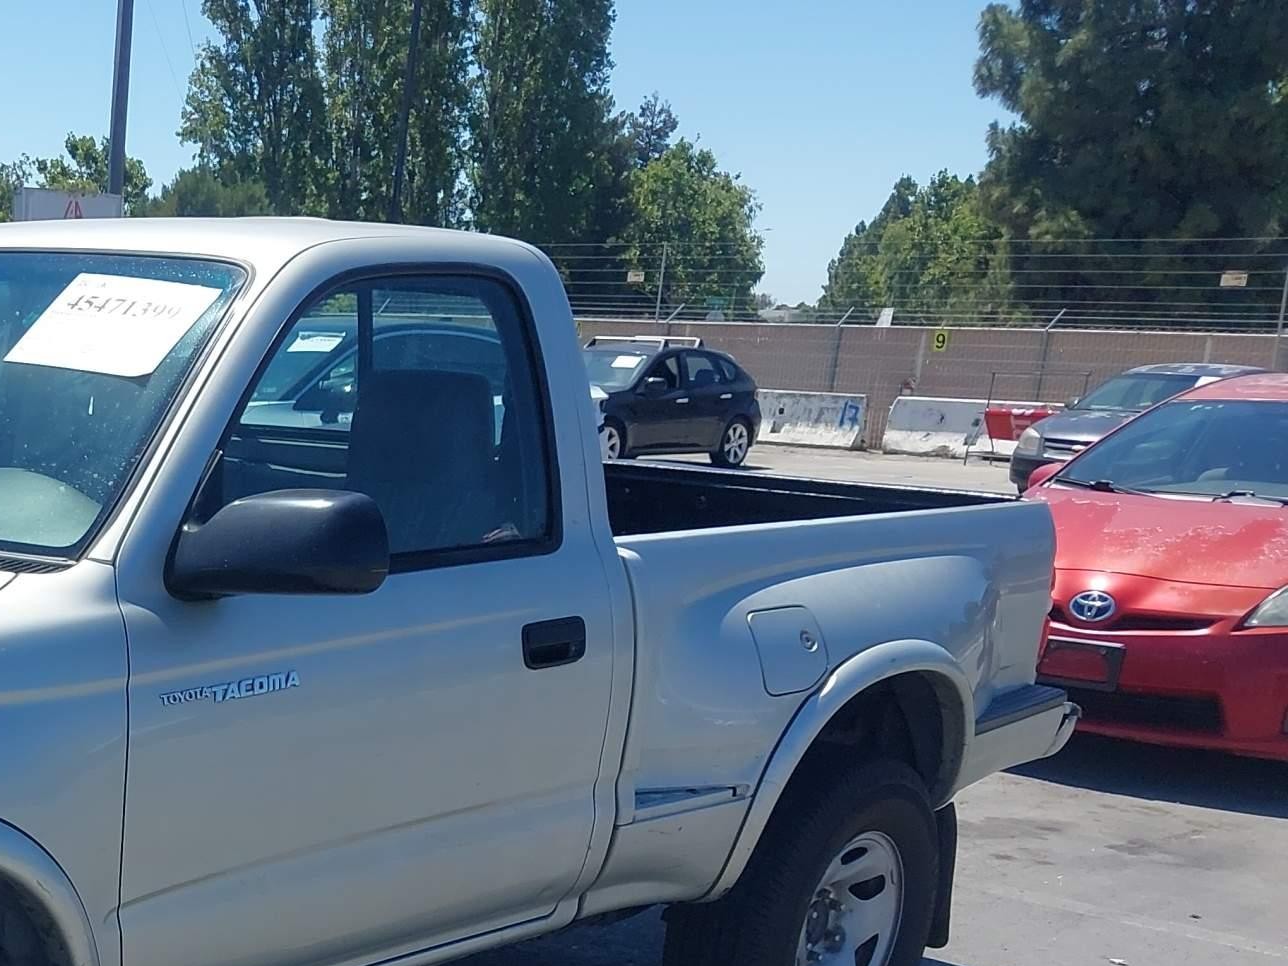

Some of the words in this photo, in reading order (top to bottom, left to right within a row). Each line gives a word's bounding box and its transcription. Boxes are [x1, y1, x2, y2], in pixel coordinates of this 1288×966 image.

[67, 294, 183, 319] 45471399
[935, 332, 947, 349] 9
[161, 687, 212, 706] TOYOTA
[212, 670, 301, 703] TACOMA
